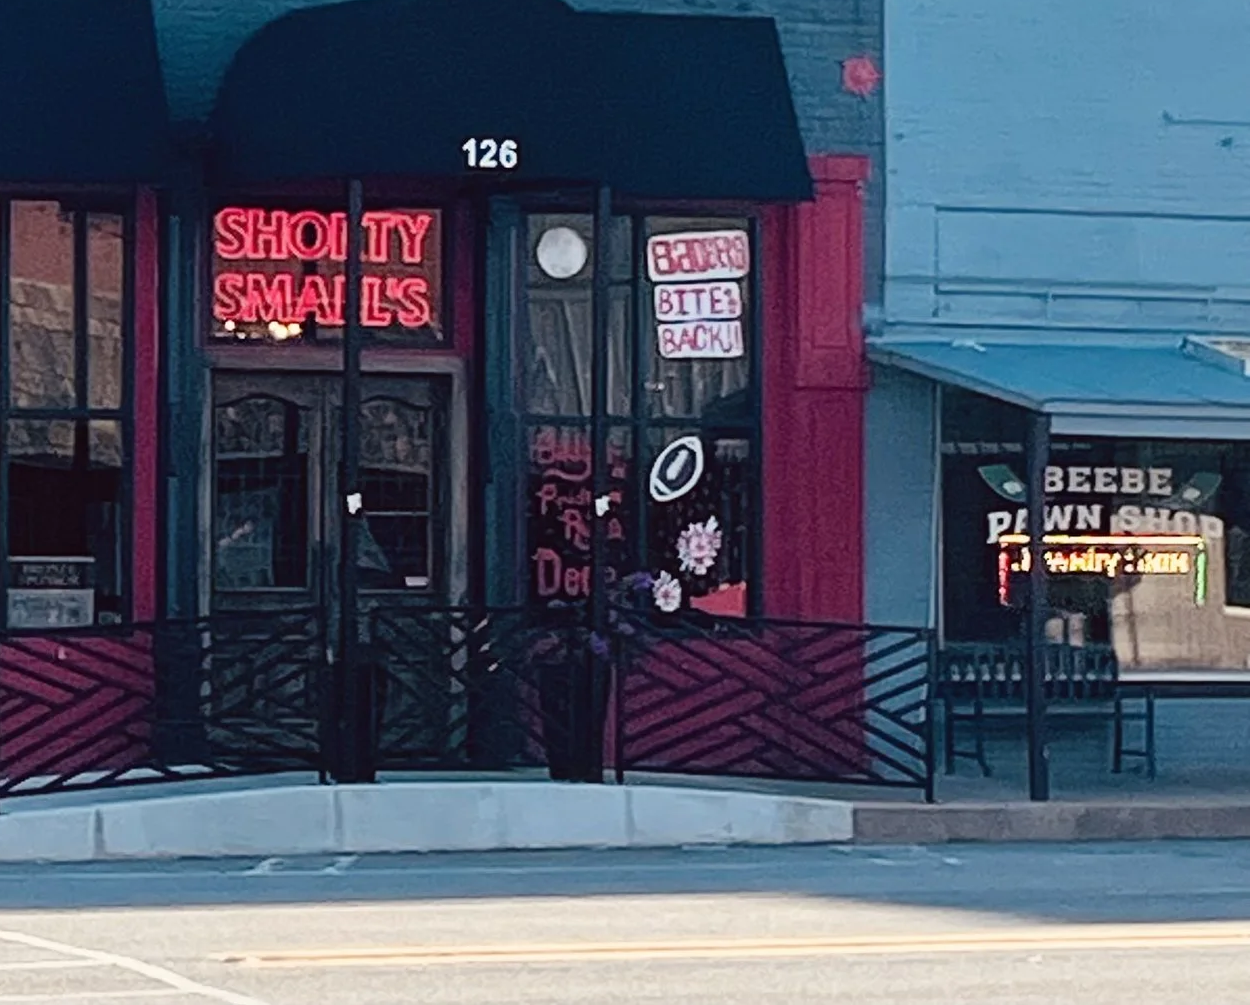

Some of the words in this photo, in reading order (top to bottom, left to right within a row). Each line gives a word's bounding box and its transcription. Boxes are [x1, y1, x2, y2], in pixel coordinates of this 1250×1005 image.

[462, 138, 518, 168] 126
[1044, 466, 1172, 496] BEEBE
[1117, 504, 1224, 539] SHOP
